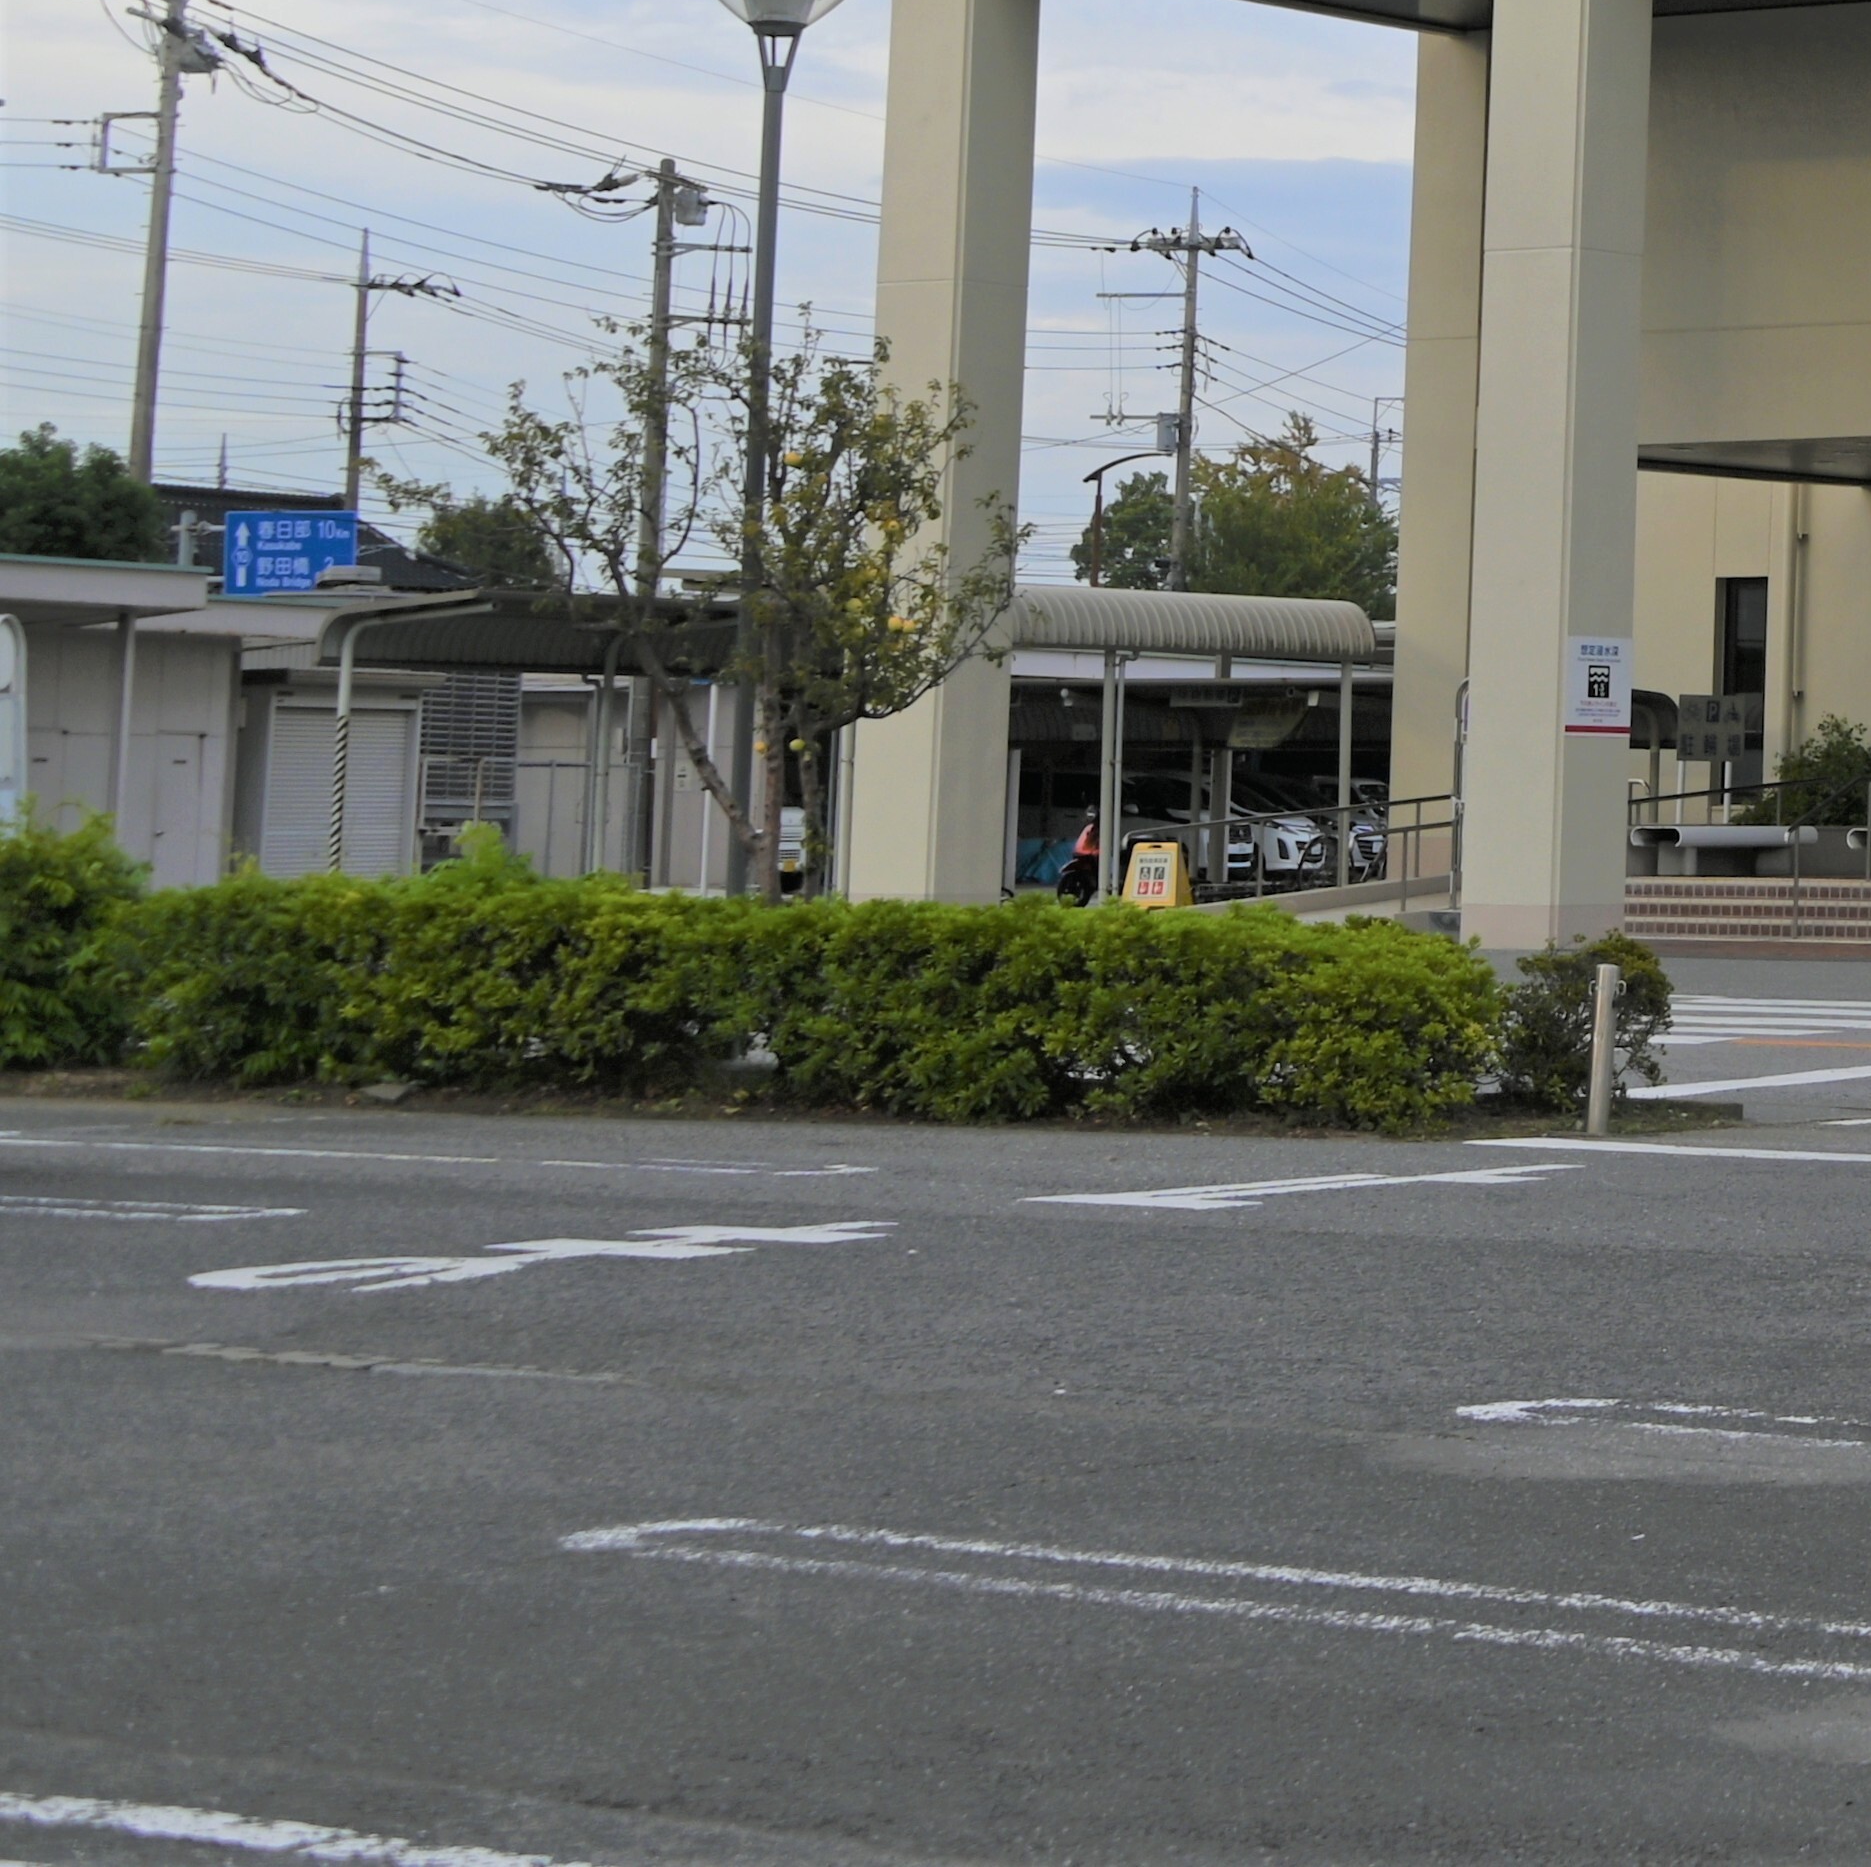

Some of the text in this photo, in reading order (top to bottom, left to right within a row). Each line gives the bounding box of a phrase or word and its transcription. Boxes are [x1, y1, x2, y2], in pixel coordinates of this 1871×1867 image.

[258, 520, 311, 539] 春日部
[257, 541, 302, 550] Kasukabe
[256, 557, 311, 575] 野田橋
[255, 577, 313, 589] Noda Bridge
